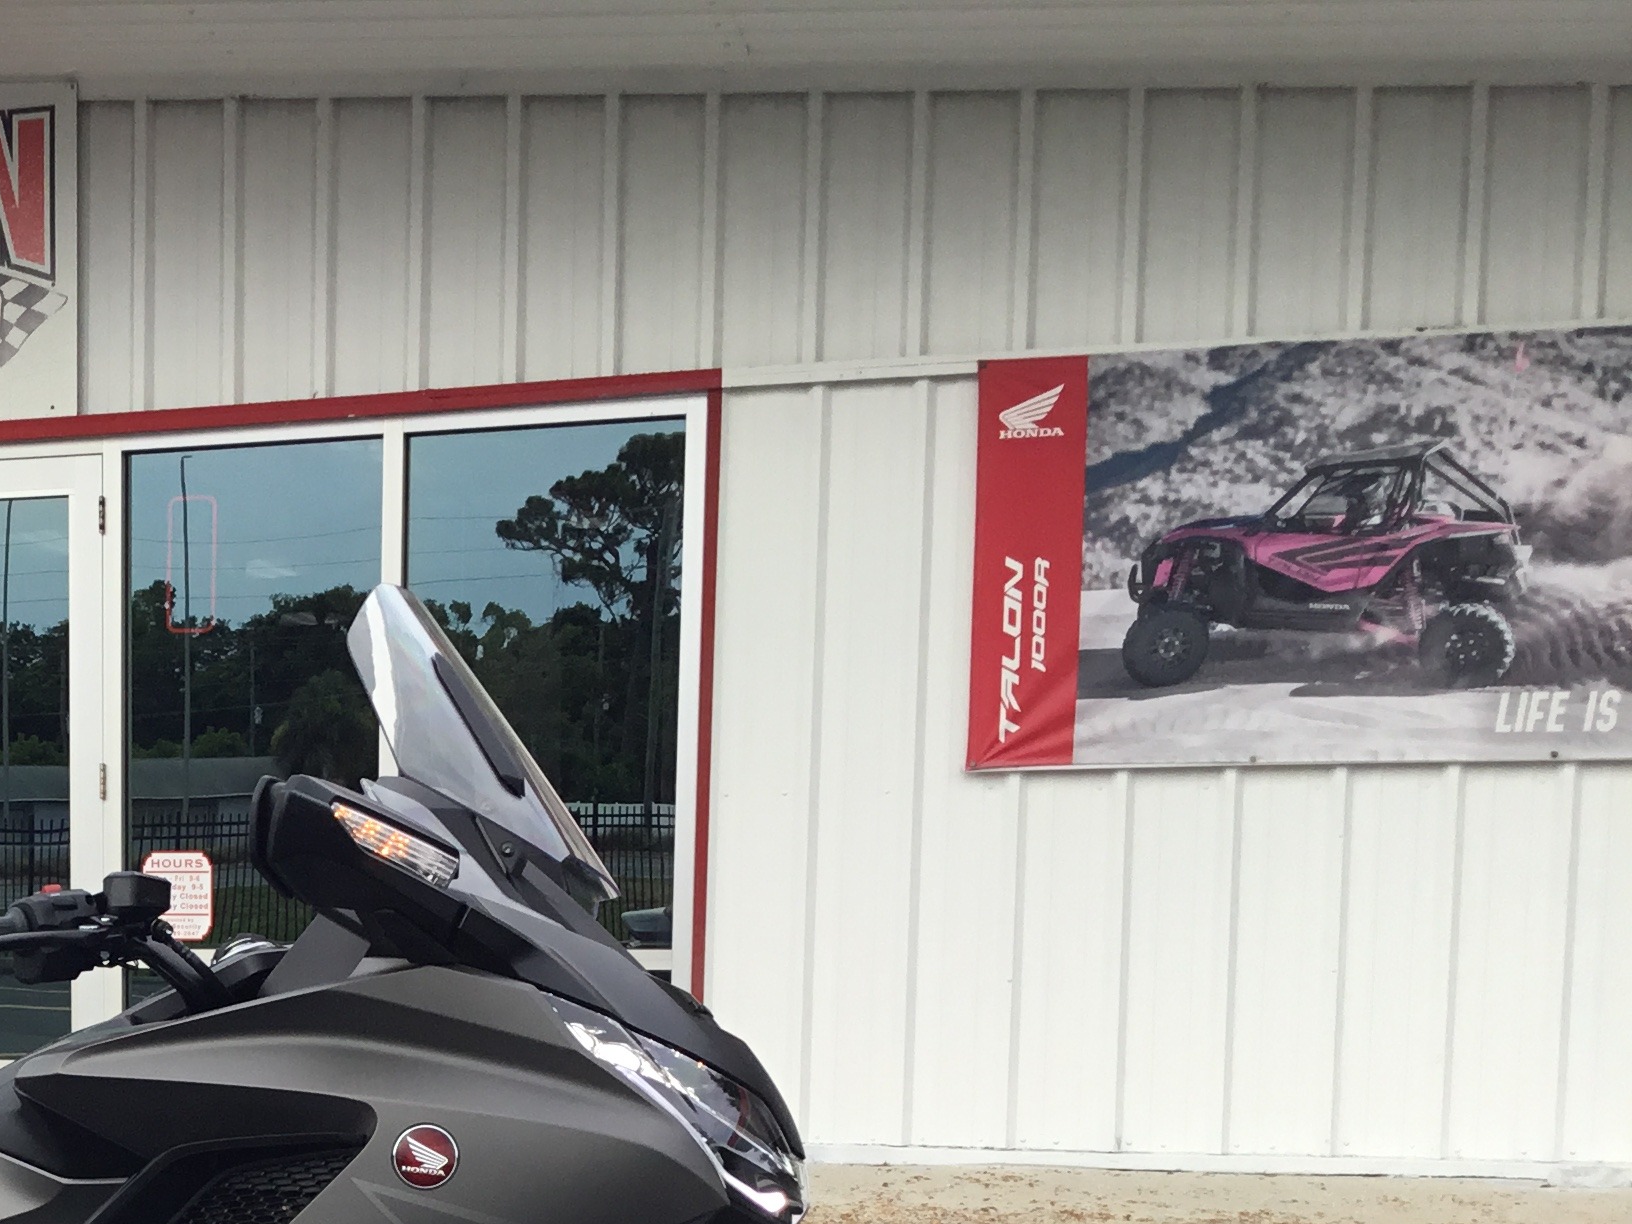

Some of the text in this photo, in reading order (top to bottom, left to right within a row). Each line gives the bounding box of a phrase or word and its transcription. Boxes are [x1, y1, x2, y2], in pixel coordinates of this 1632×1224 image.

[999, 427, 1065, 439] HONDA
[1031, 557, 1050, 672] 1000R
[999, 556, 1024, 743] TALON
[1495, 689, 1622, 732] LIFE IS
[151, 859, 204, 869] HOURS
[179, 892, 208, 900] Closed
[179, 902, 209, 910] Closed
[401, 1165, 446, 1177] HONDA
